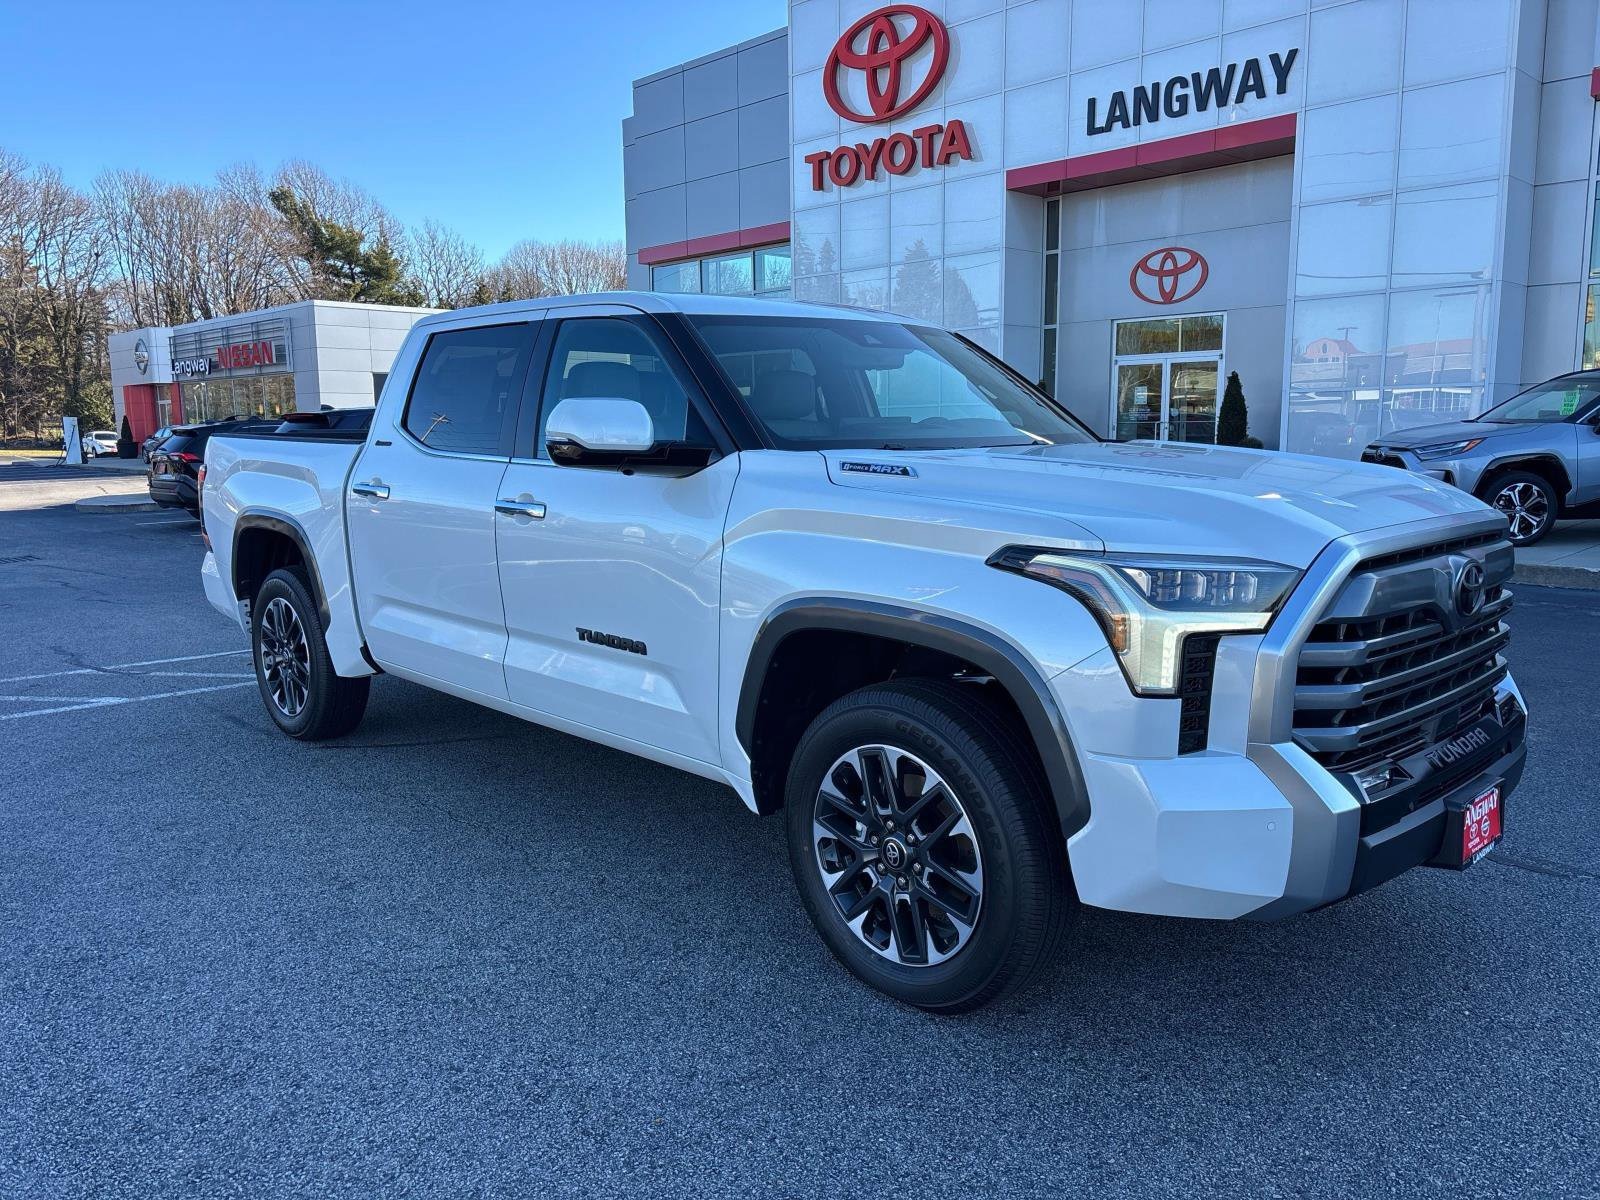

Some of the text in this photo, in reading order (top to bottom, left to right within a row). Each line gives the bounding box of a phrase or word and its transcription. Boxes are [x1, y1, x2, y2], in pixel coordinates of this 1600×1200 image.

[1087, 48, 1299, 136] LANGWAY
[805, 119, 972, 191] TOYOTA
[171, 341, 275, 377] Langway NISSAN
[869, 464, 903, 474] MAX
[576, 627, 647, 655] TUNDRA
[1425, 727, 1490, 768] TUNDRA
[1464, 788, 1498, 830] ANGWAY
